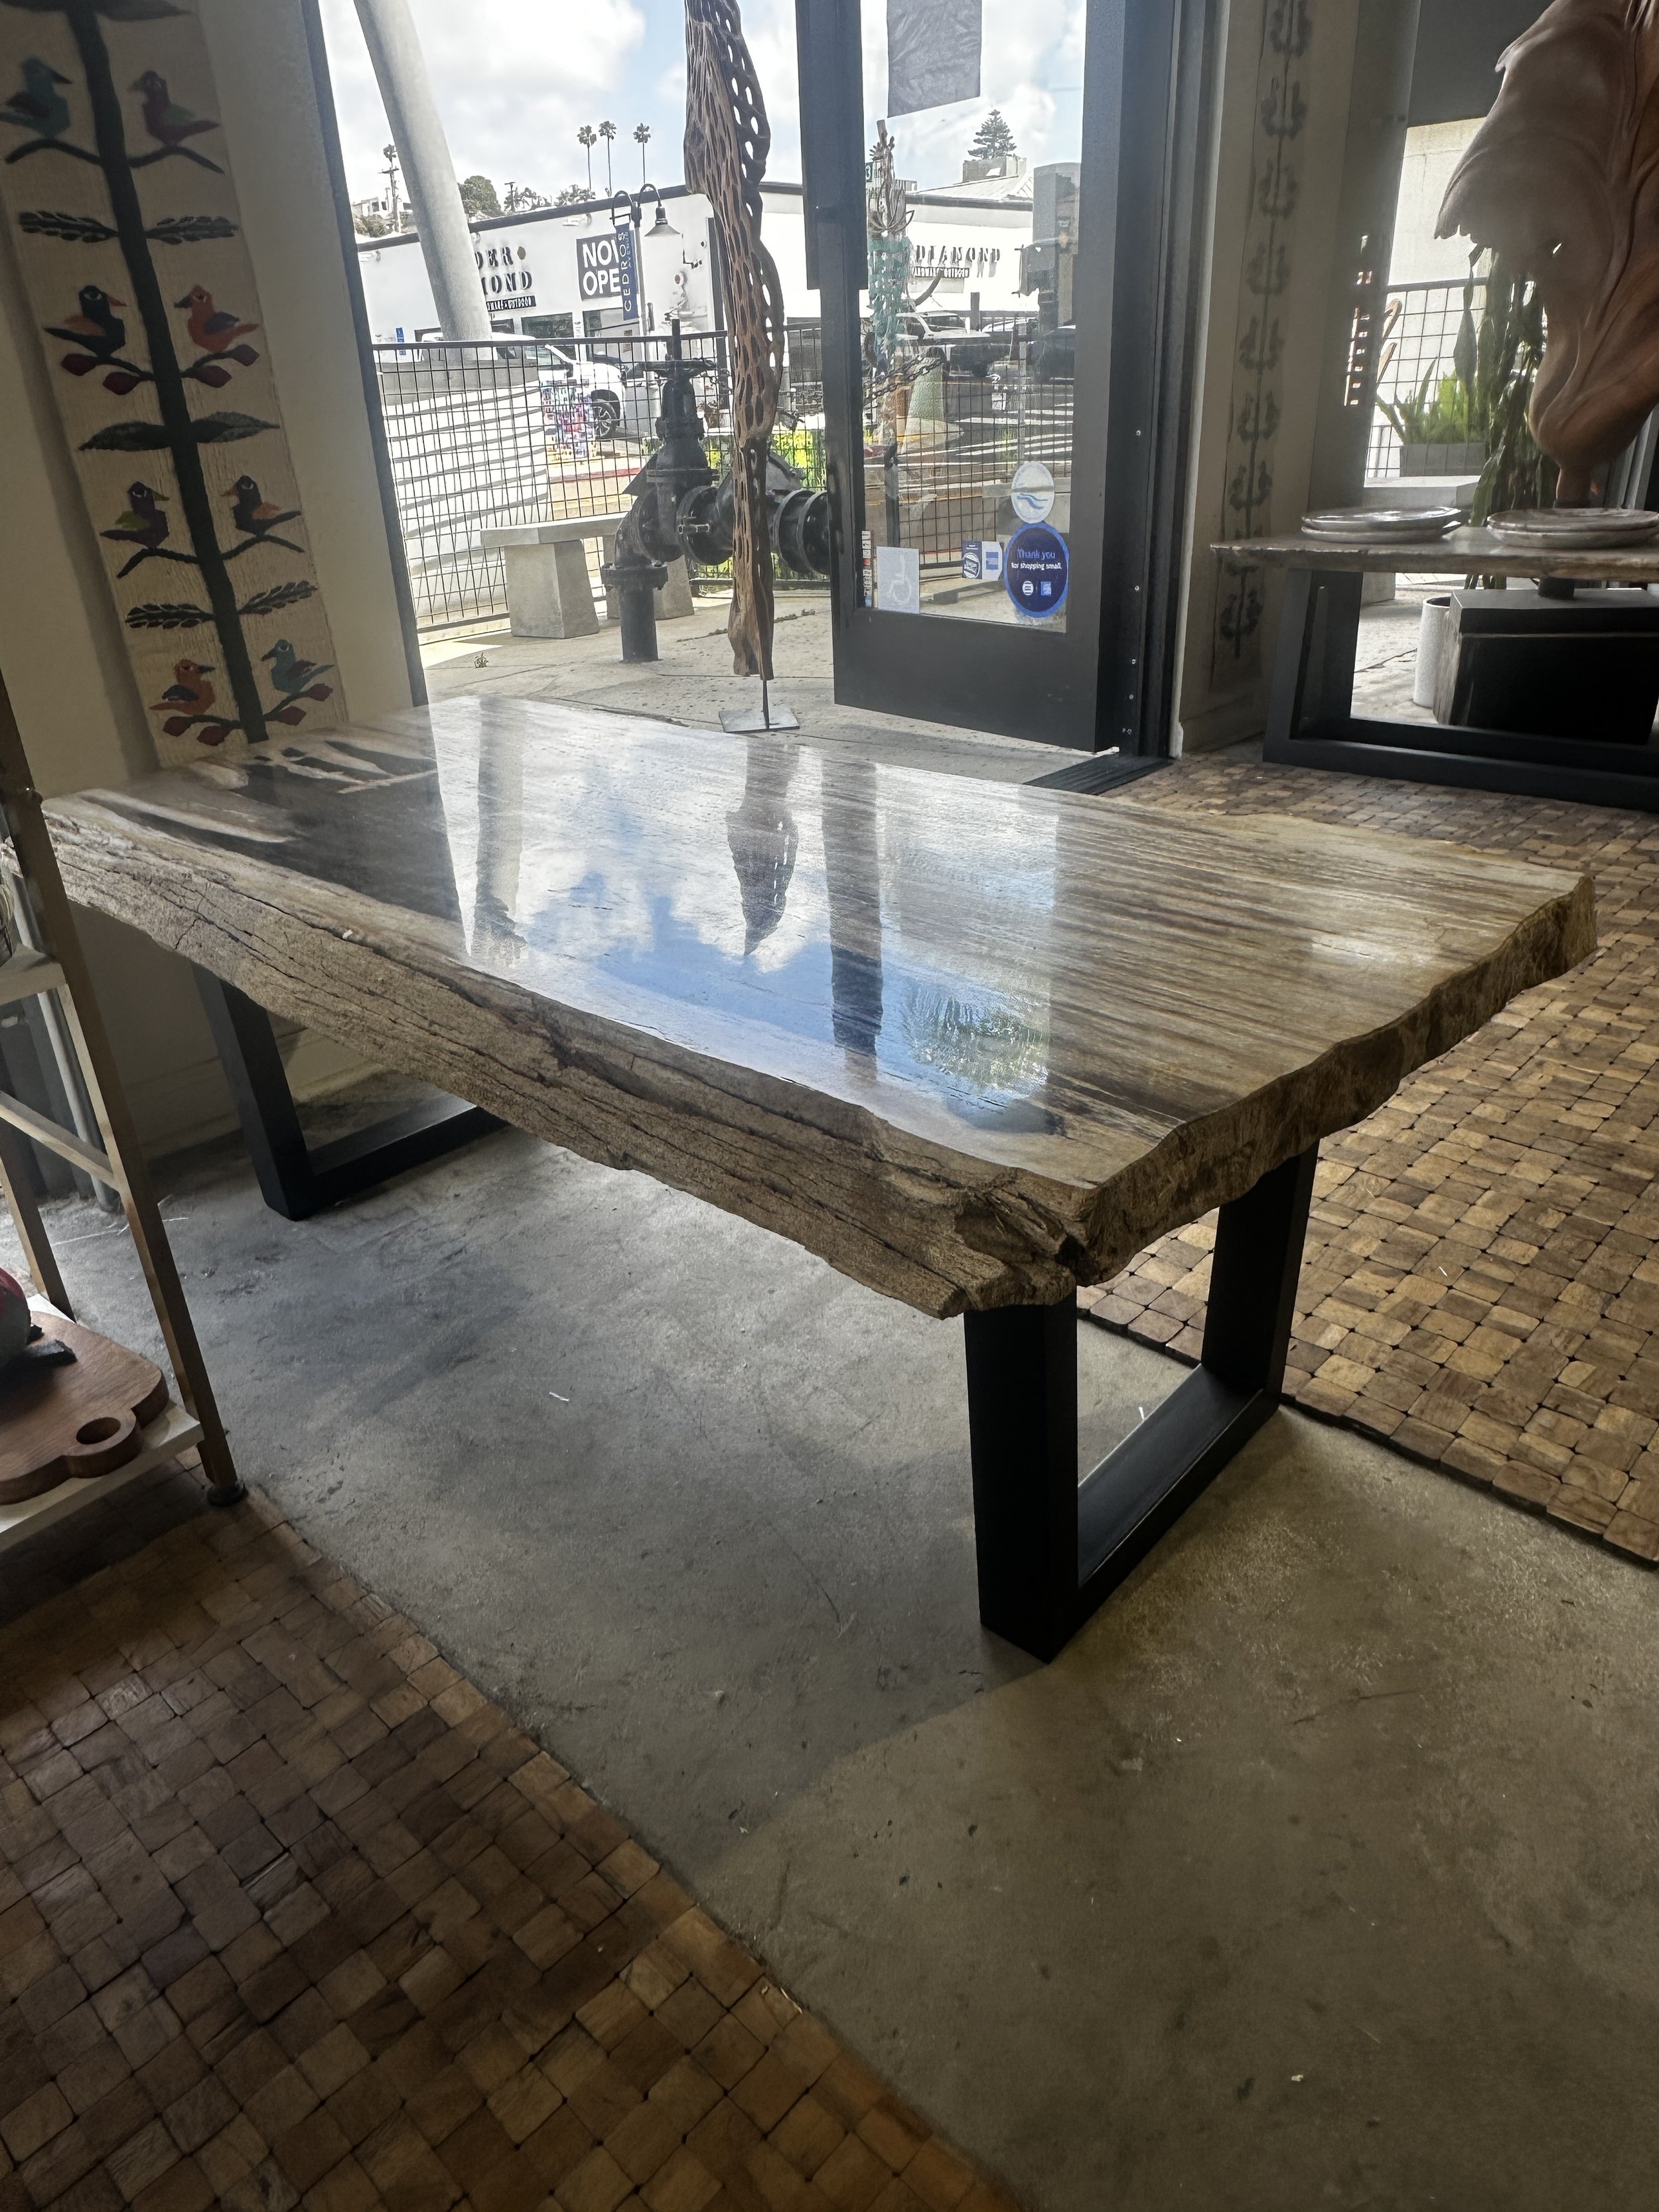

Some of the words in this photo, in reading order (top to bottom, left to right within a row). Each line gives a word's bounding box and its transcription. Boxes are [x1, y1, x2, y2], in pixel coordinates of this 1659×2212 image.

[583, 267, 621, 296] OPE
[618, 232, 632, 312] CEDROS
[1017, 548, 1040, 559] Thank
[1041, 551, 1056, 561] you
[1020, 561, 1045, 571] shopping
